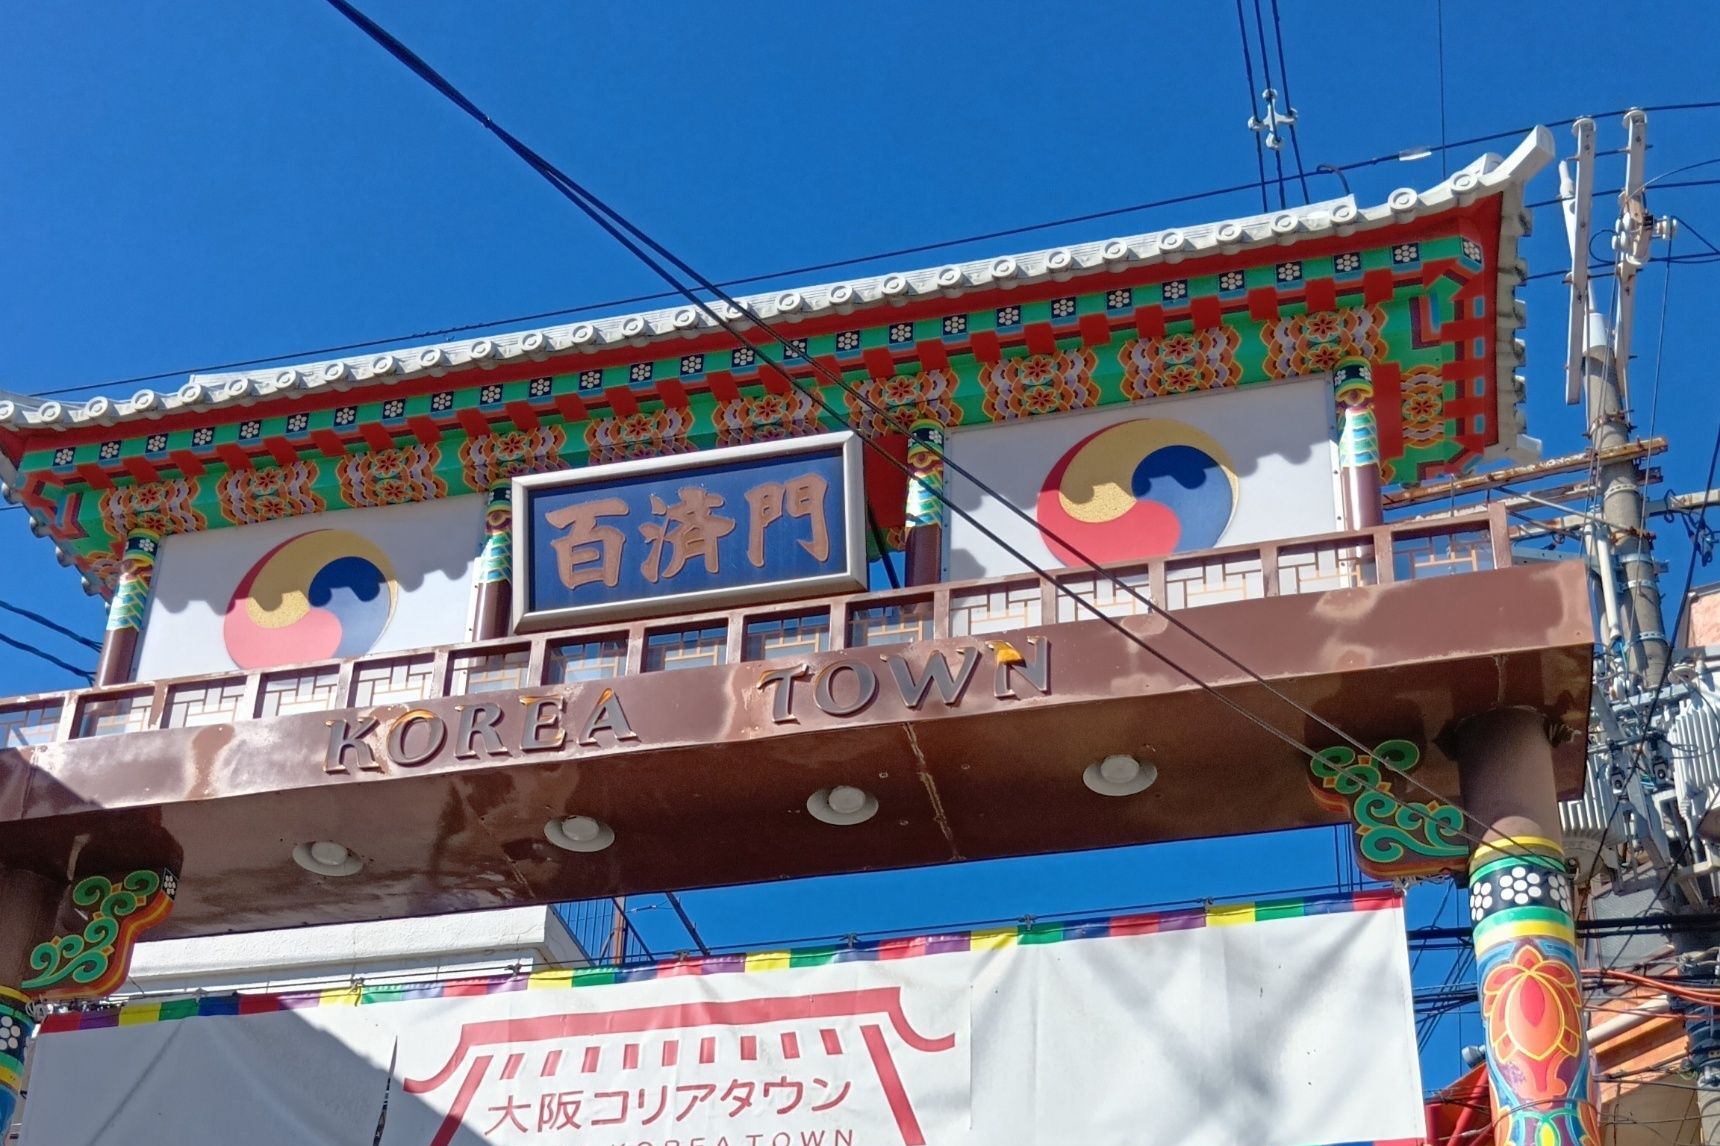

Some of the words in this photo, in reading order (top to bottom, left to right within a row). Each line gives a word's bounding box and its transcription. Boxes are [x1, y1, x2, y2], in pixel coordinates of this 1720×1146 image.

[544, 472, 830, 591] 百済門
[322, 687, 641, 774] KOREA
[756, 635, 1052, 725] TOWN
[483, 1075, 852, 1137] 大阪コリアタウン
